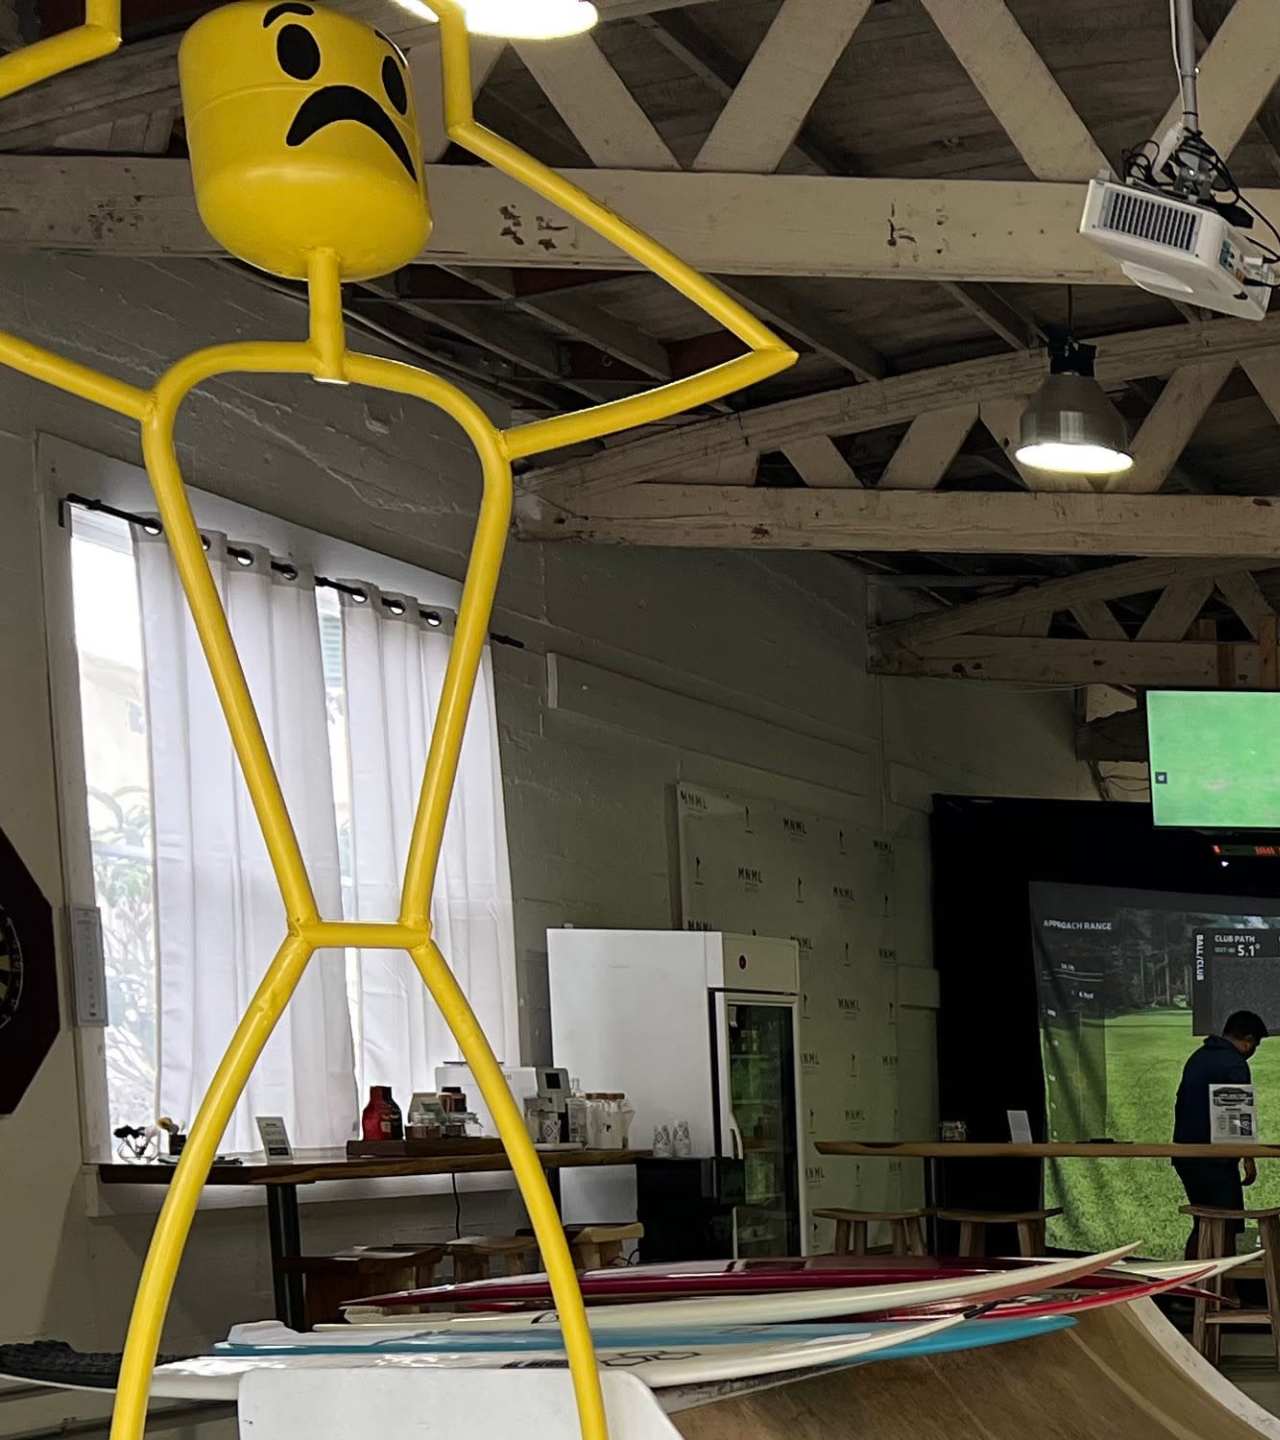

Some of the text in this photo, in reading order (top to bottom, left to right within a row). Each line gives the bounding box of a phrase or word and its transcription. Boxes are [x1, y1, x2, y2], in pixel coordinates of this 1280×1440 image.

[738, 867, 763, 883] MNML
[1214, 935, 1255, 943] CLUB PATH
